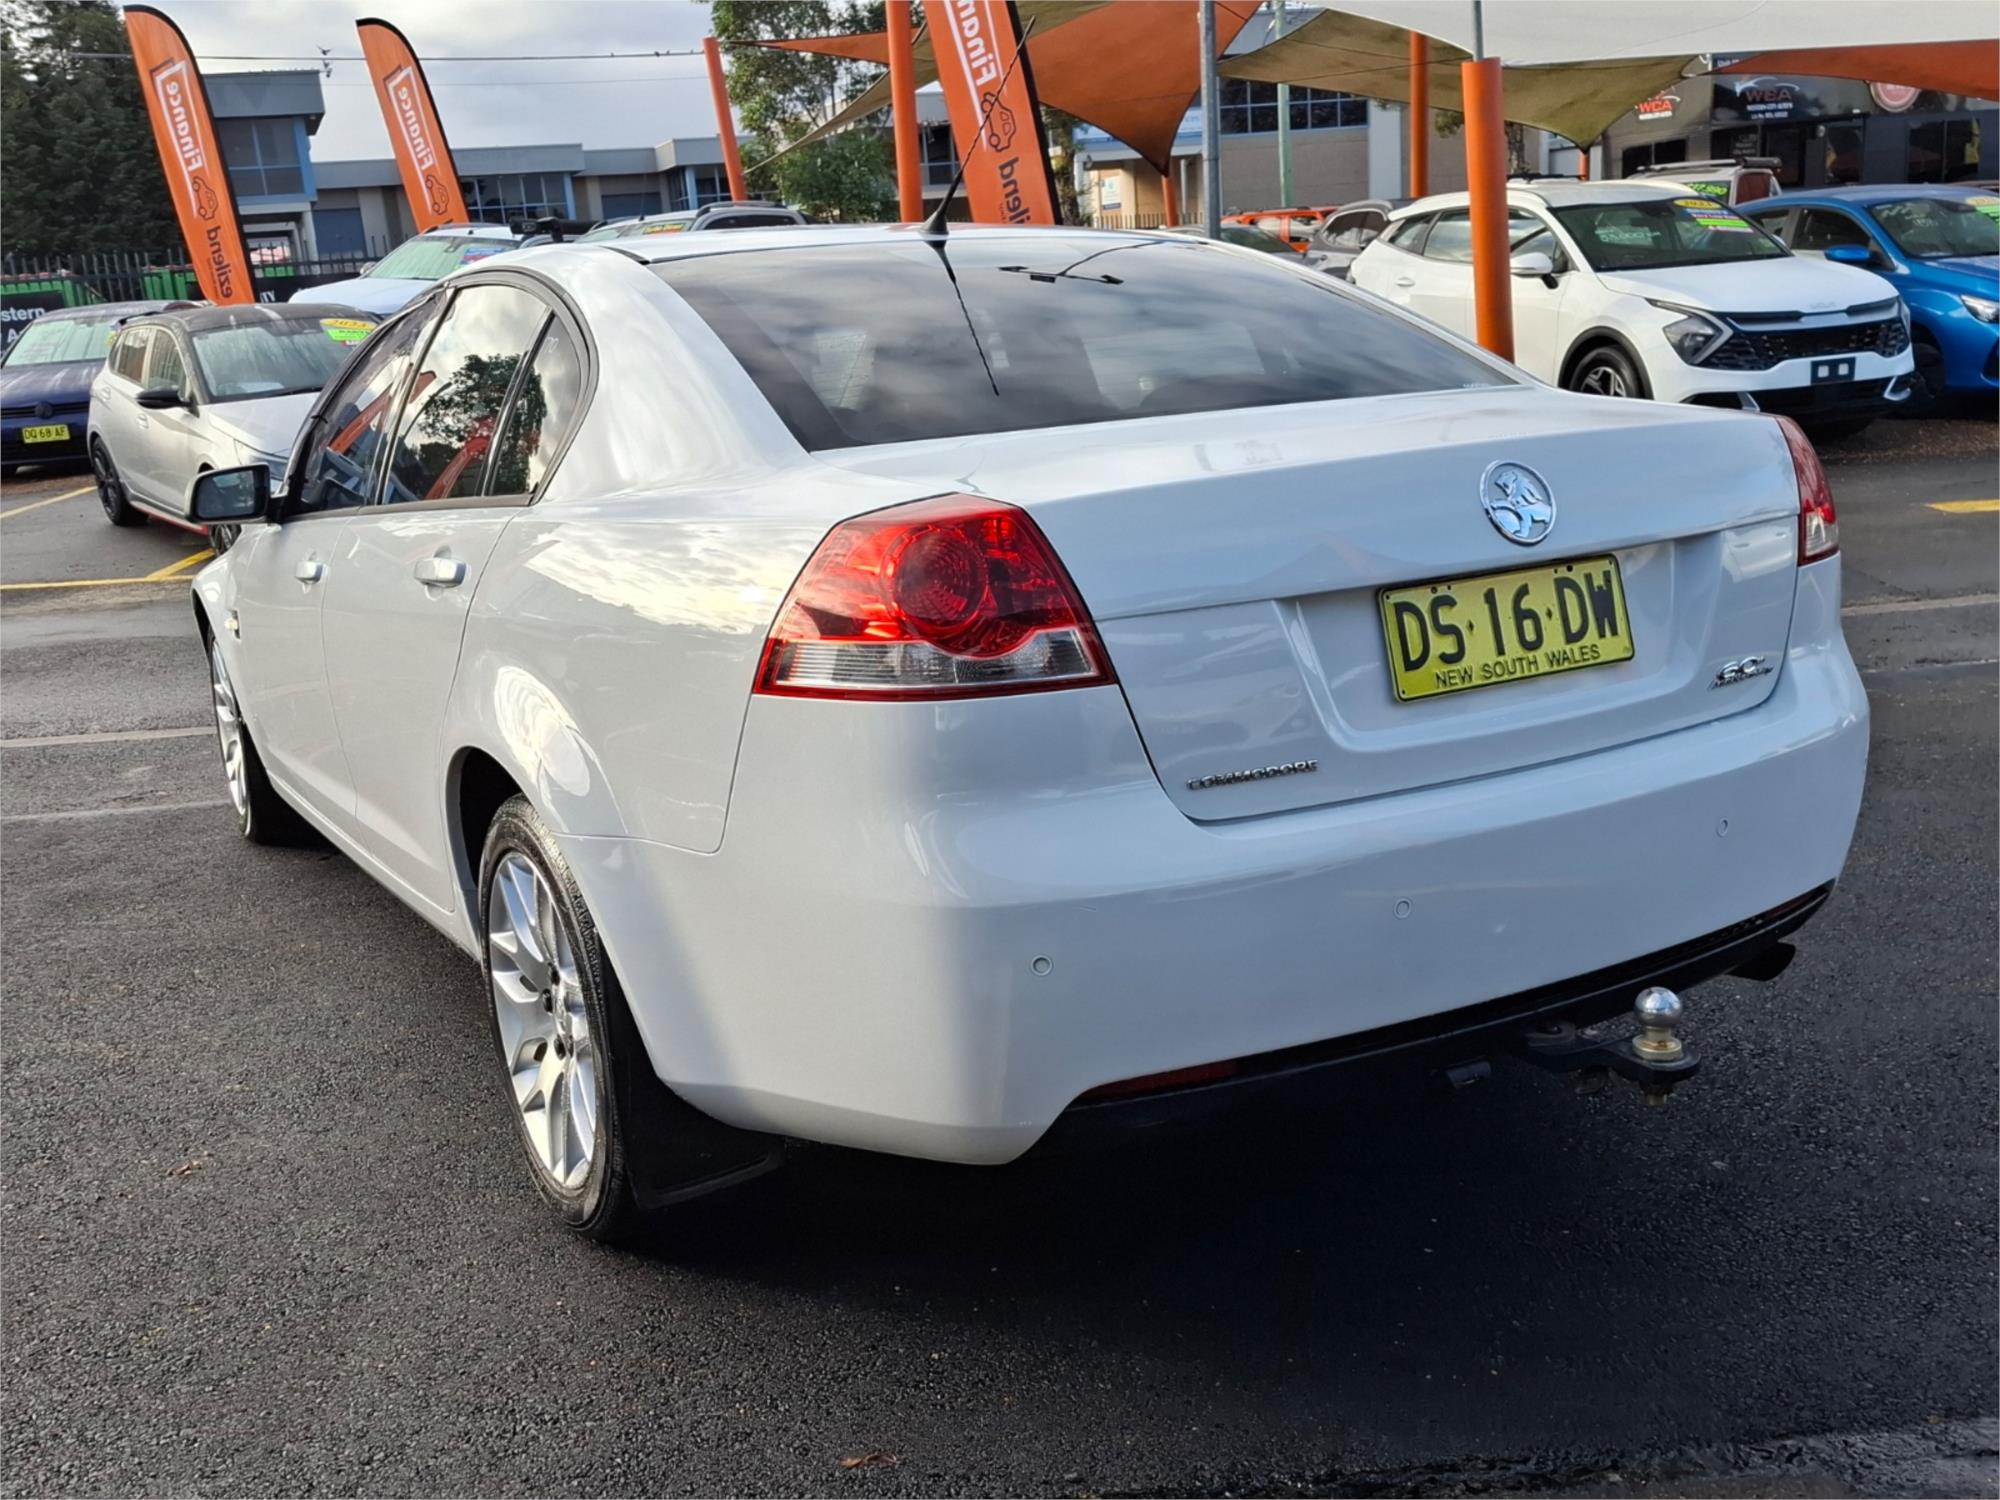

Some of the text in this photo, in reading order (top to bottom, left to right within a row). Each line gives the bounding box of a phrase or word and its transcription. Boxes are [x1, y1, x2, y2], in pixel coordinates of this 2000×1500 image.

[1435, 643, 1601, 689] NEW SOUTH WALES
[1186, 759, 1318, 791] COMMODORE
